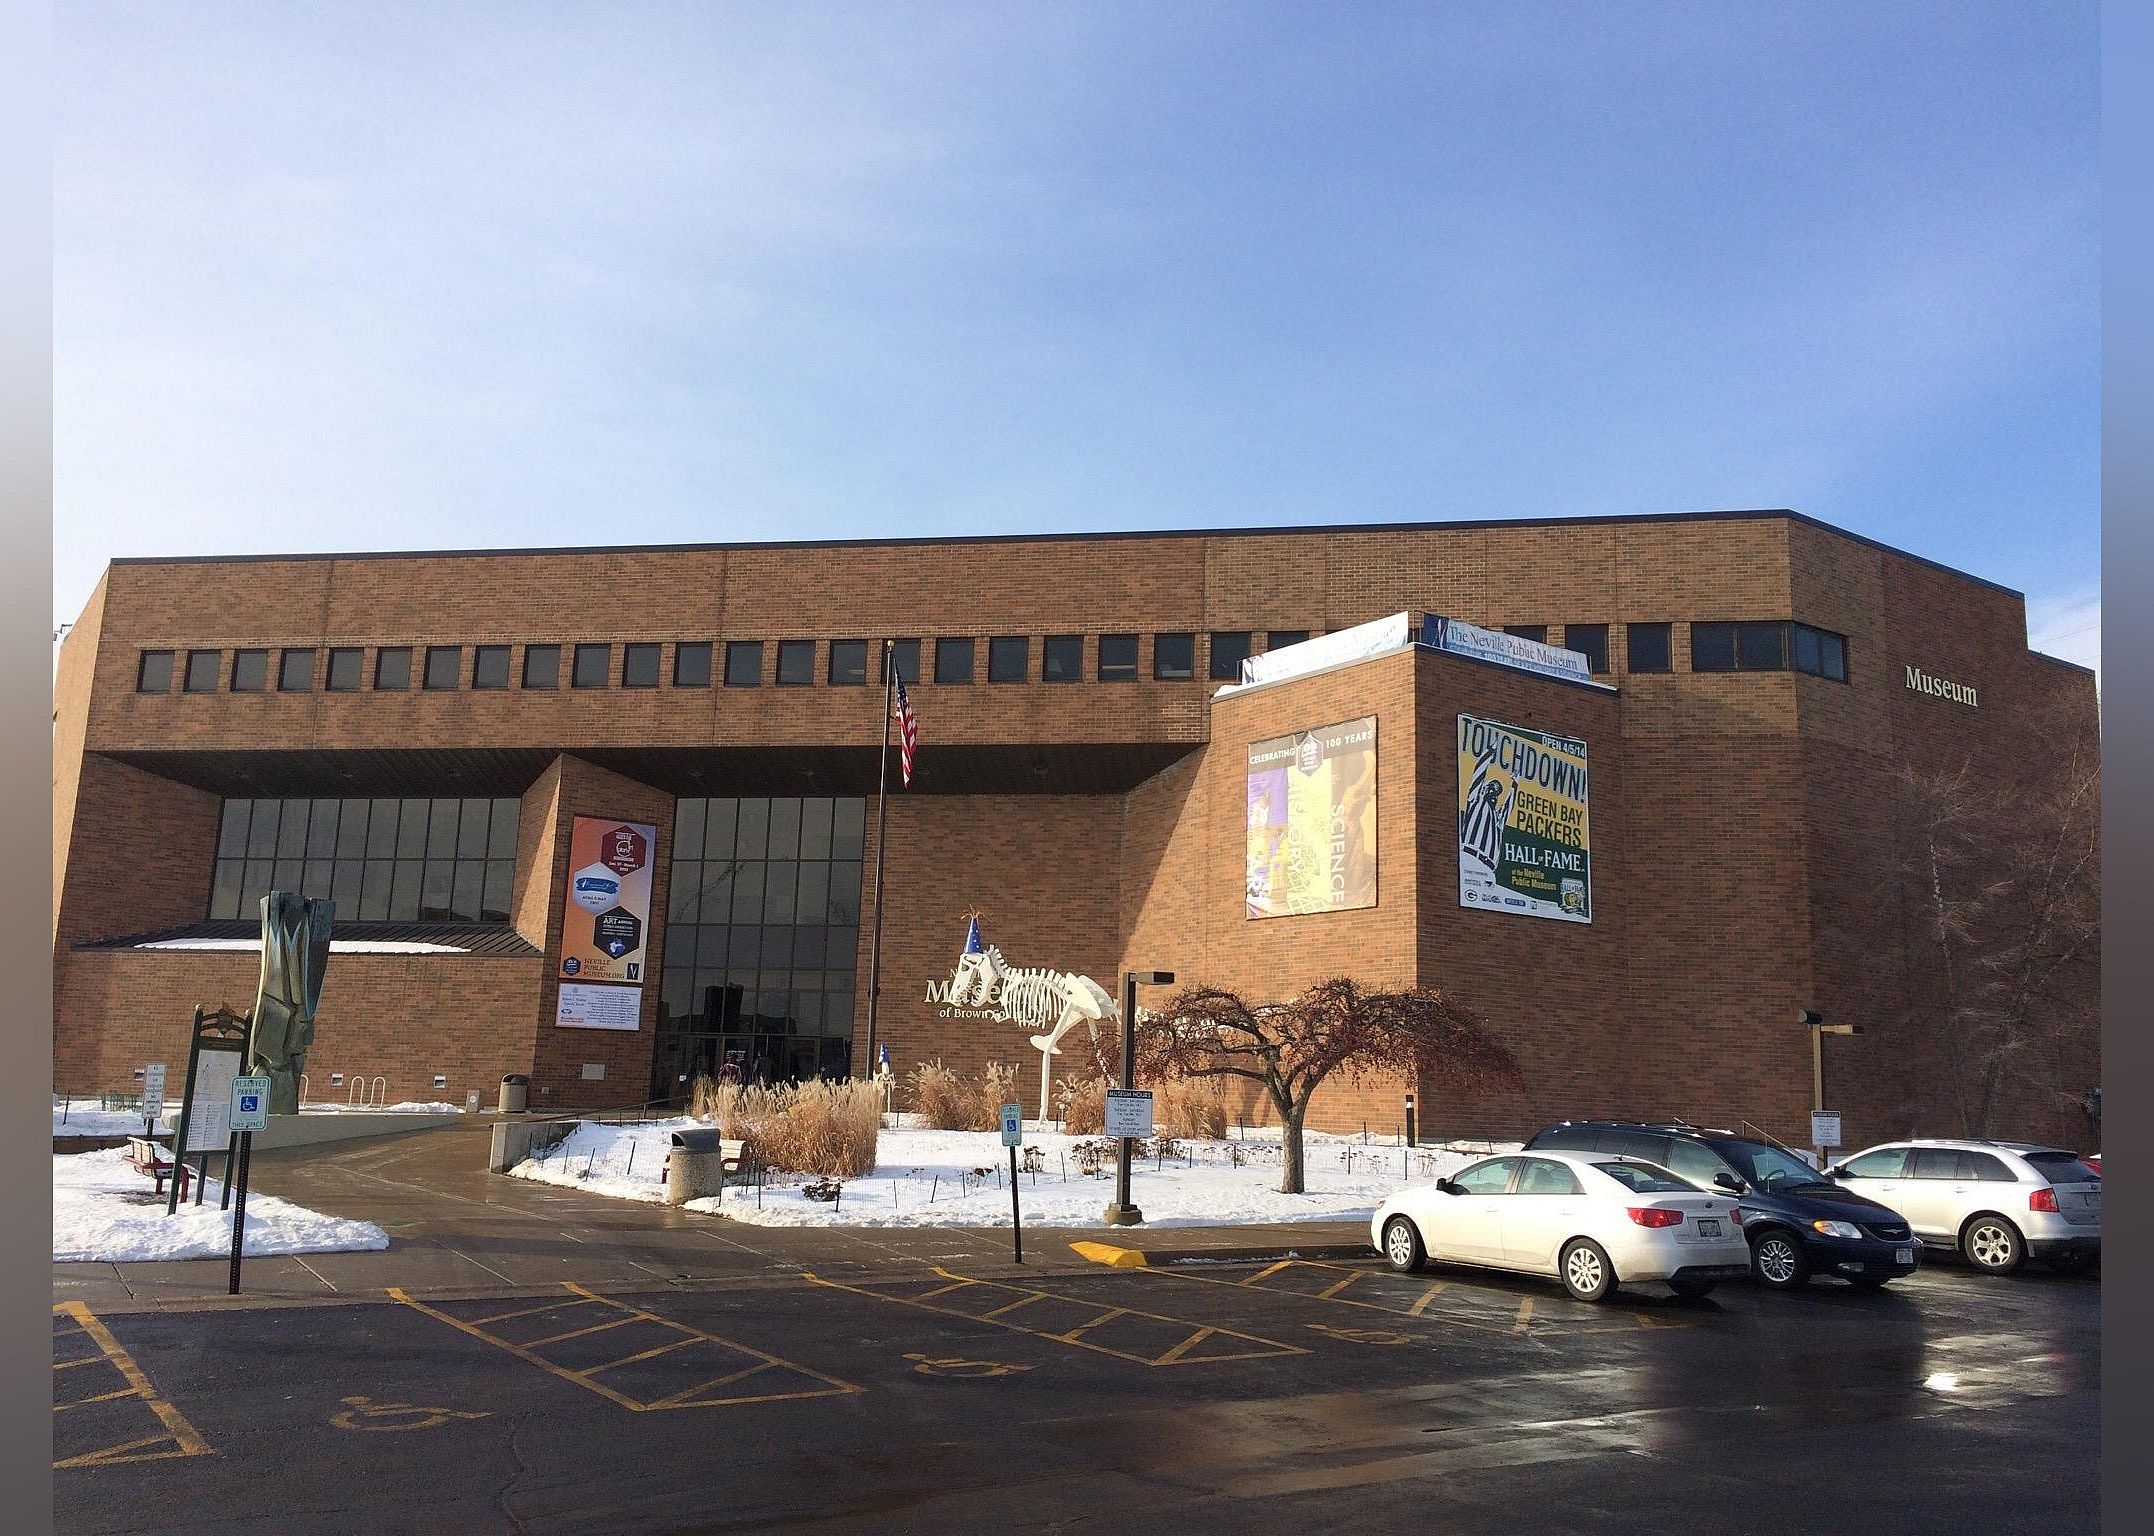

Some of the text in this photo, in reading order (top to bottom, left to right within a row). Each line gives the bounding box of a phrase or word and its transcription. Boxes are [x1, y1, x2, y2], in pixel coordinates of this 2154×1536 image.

[1450, 626, 1468, 643] The
[1470, 631, 1505, 652] Neville
[1537, 648, 1578, 670] Museum
[1905, 665, 1978, 707] Museum
[1249, 748, 1296, 765] CELEBRATING
[1326, 738, 1341, 749] 100
[1344, 730, 1373, 745] YEARS
[1462, 717, 1587, 804] TOUCHDOWN!
[1541, 736, 1561, 751] OPEN
[1517, 790, 1583, 826] GREEN BAY
[1516, 809, 1582, 848] PACKERS
[1330, 804, 1345, 903] SCIENCE
[1504, 842, 1539, 866] HALL
[1544, 849, 1582, 872] FAME
[603, 917, 618, 925] ART
[939, 1007, 952, 1018] of
[954, 1008, 988, 1019] Brown
[237, 1088, 263, 1096] PARKING
